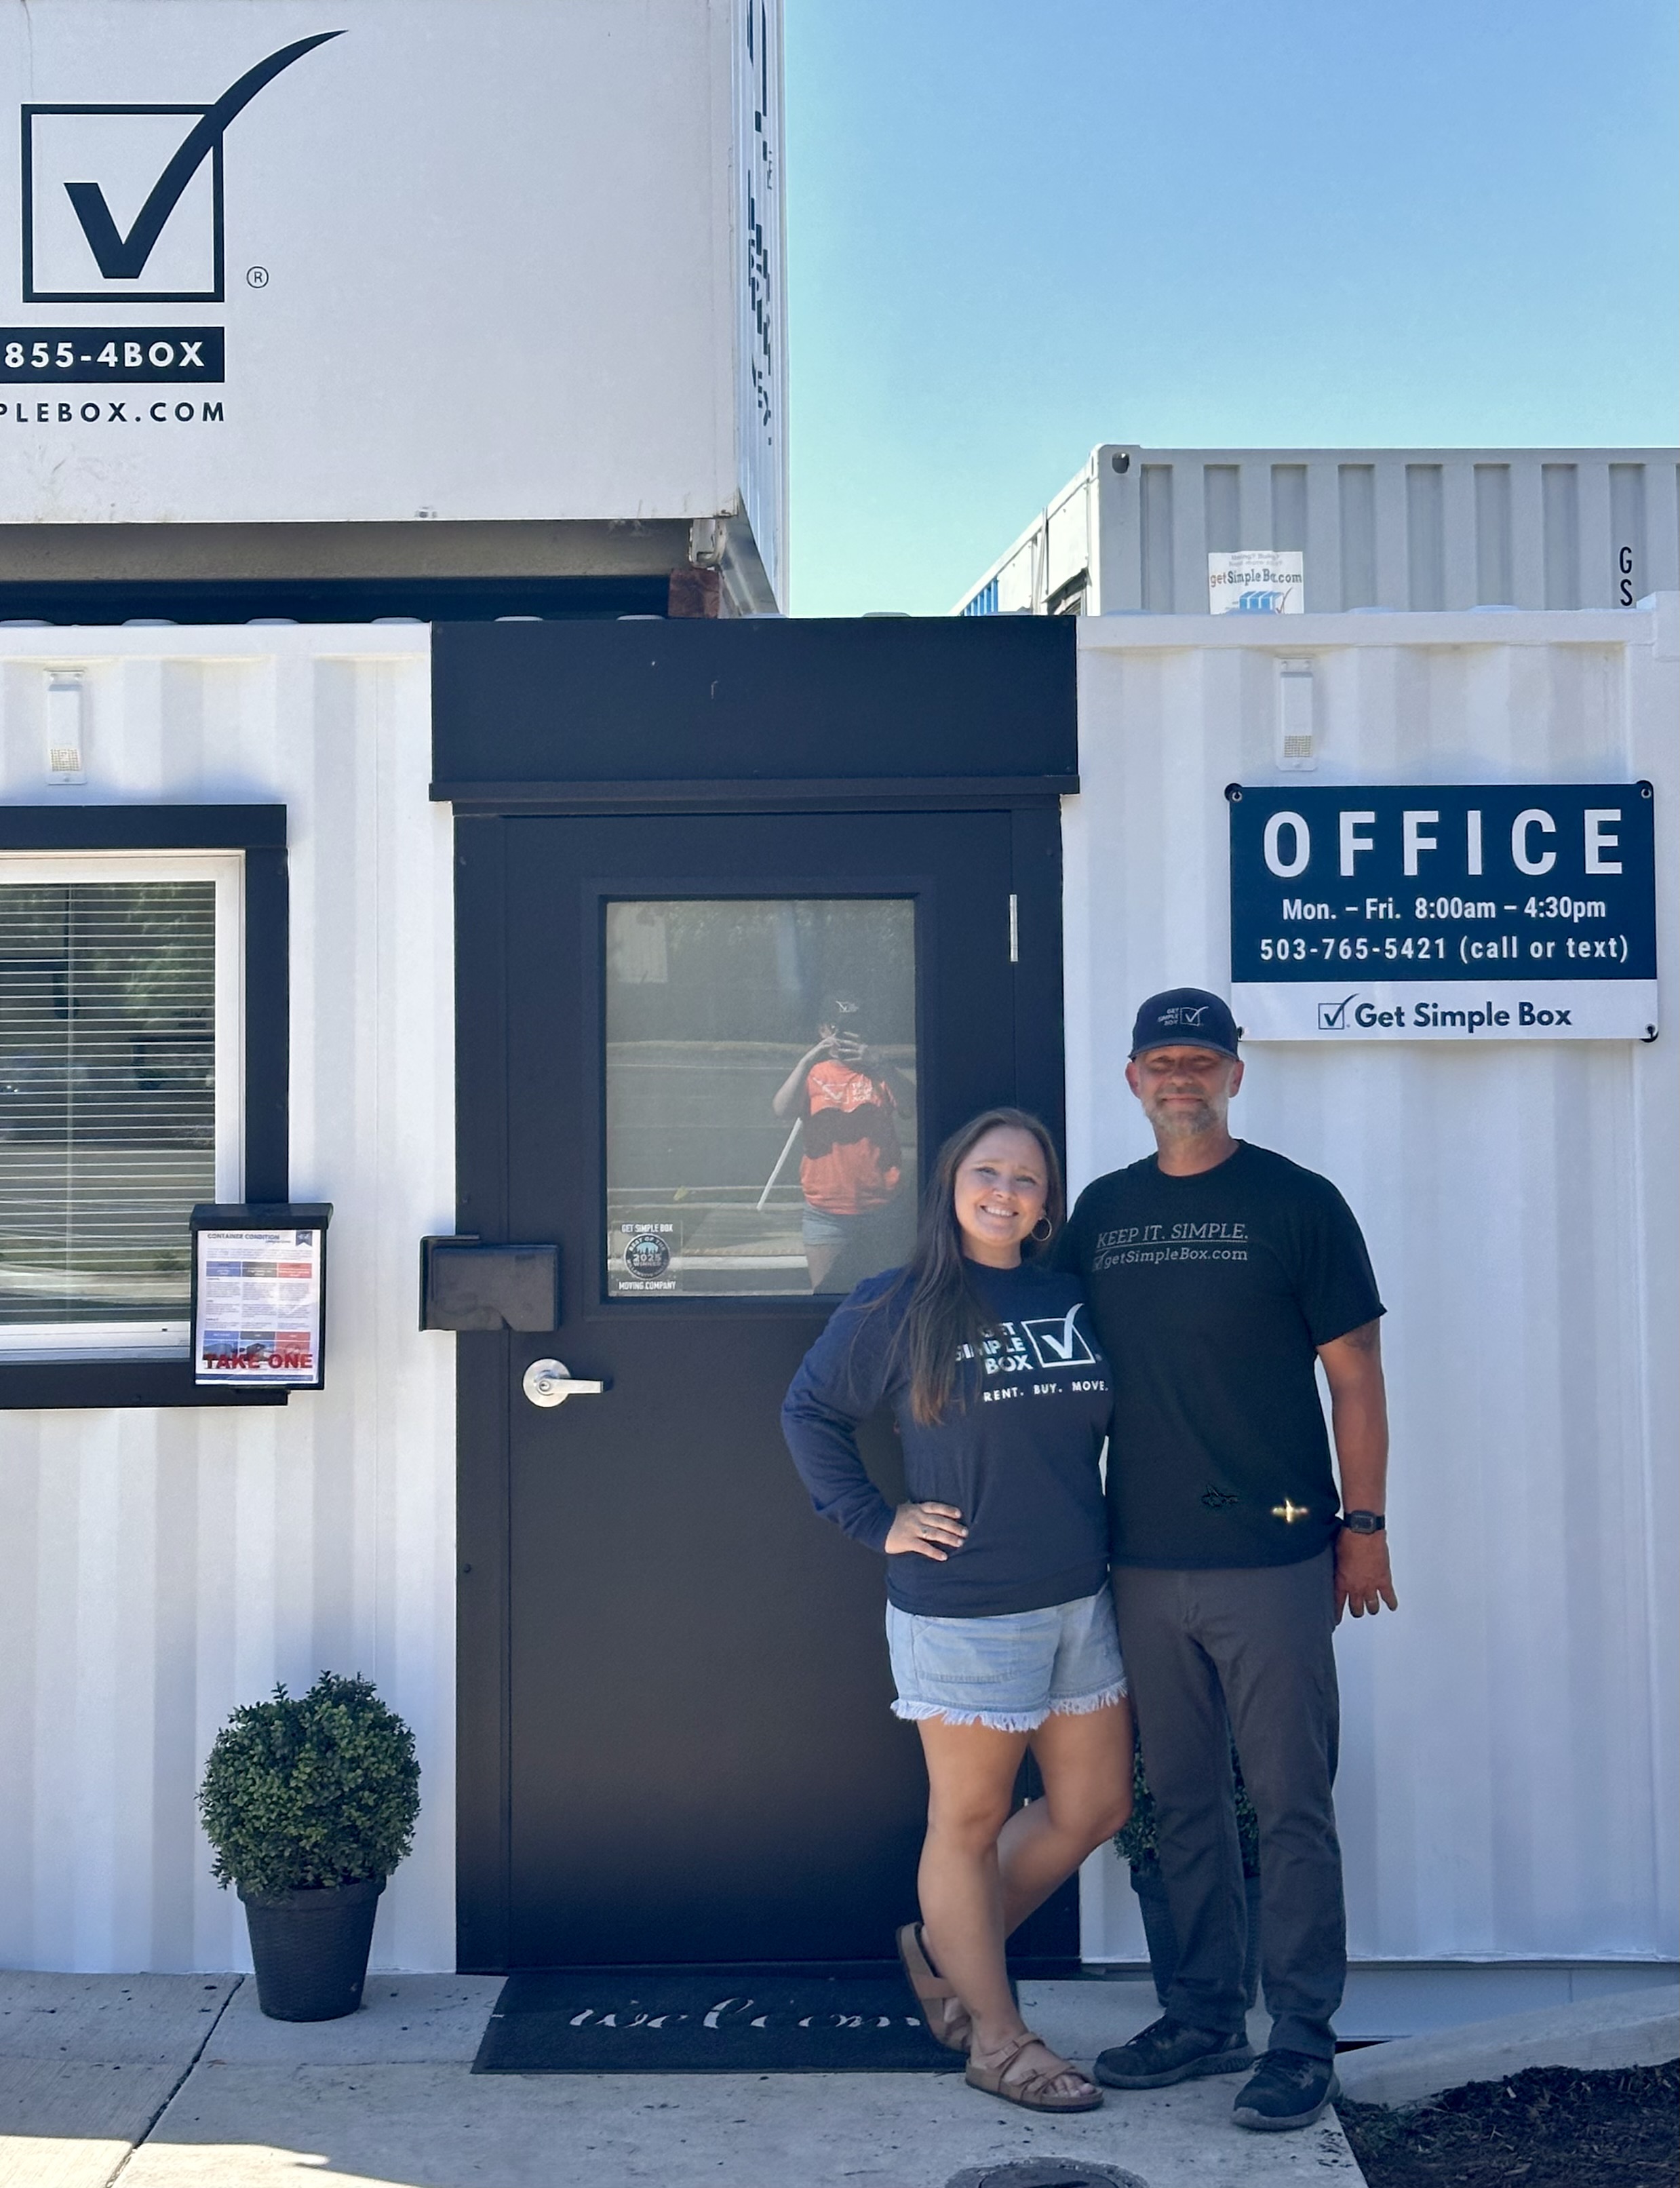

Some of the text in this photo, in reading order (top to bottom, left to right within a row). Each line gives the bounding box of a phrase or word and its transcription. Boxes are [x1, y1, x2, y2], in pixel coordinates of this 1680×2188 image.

[4, 342, 205, 368] 855-4BOX
[1263, 808, 1623, 878] OFFICE
[1283, 898, 1337, 920] Mon.
[1365, 897, 1401, 920] Fri.
[1414, 897, 1496, 919] 8:00am
[1524, 897, 1606, 923] 4:30pm
[1260, 935, 1628, 964] 503-765-5421 (call or text)
[1354, 1001, 1572, 1033] Get Simple Box
[621, 1224, 673, 1232] GET SIMPLE BOX
[1096, 1223, 1249, 1249] KEEP IT. SIMPLE.
[1104, 1247, 1248, 1270] getSimpleBox.com
[619, 1281, 676, 1290] MOVING COMPANY
[203, 1353, 313, 1369] TAKE ONE
[985, 1354, 1034, 1375] BOX
[983, 1381, 1109, 1402] RENT. BUY. MOVE.
[570, 1997, 921, 2028] welcom
